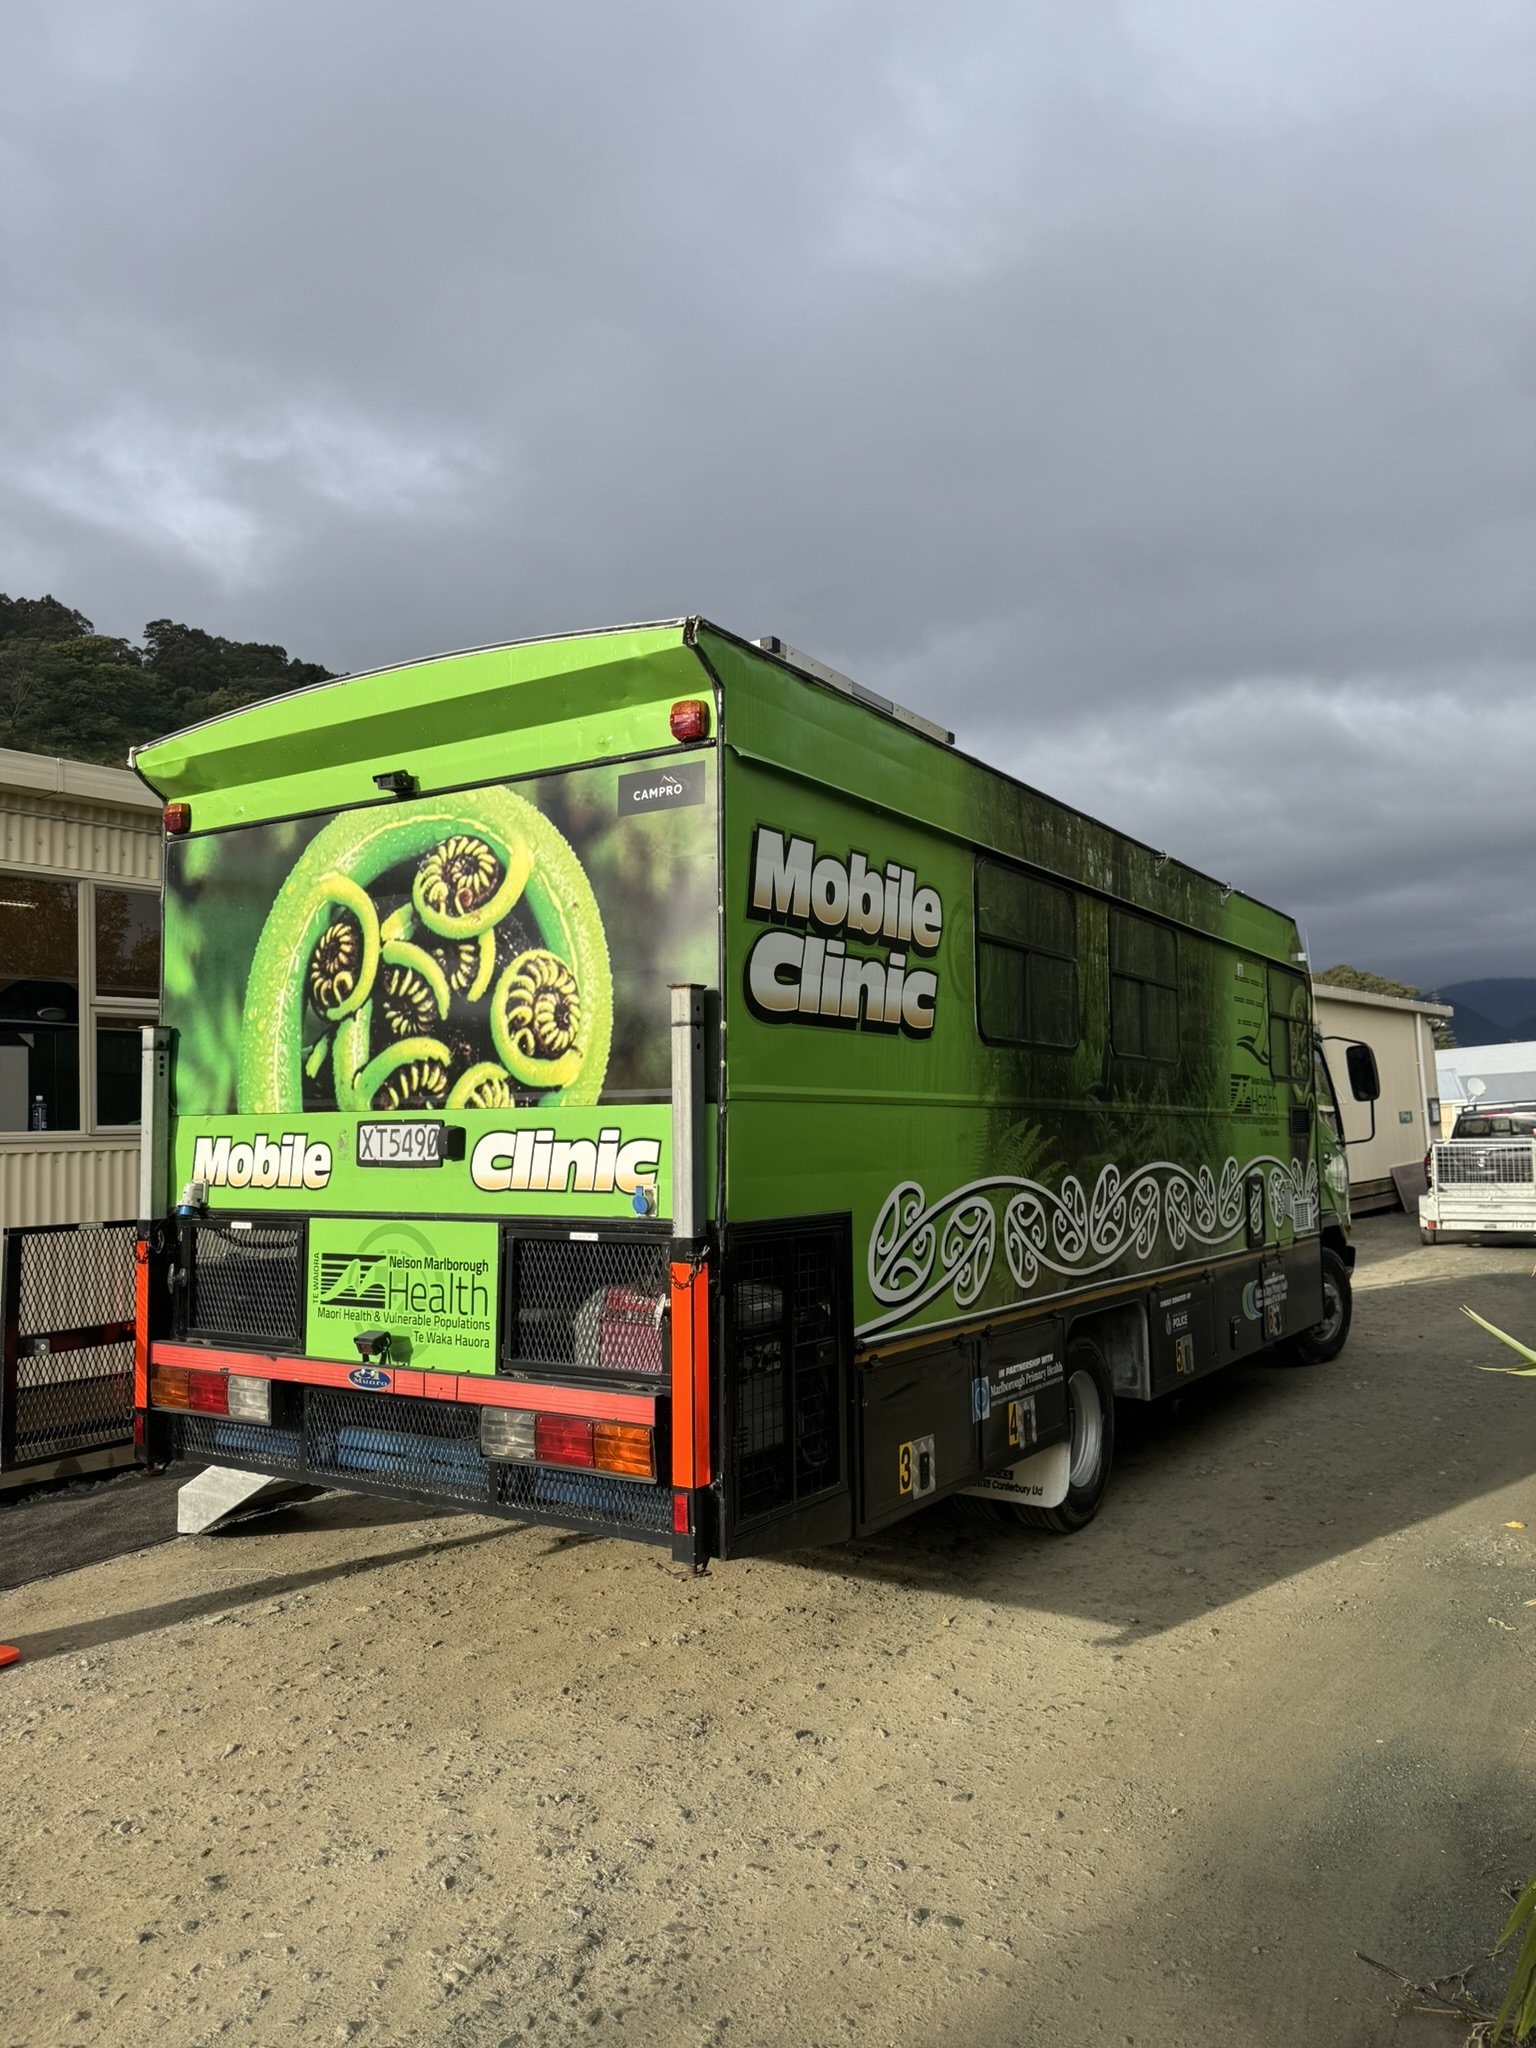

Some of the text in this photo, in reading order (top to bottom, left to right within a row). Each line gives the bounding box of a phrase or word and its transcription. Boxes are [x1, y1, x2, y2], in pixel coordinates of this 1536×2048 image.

[632, 783, 683, 801] CAMPRO
[748, 824, 943, 954] Mobile
[745, 929, 939, 1036] Clinic
[192, 1133, 333, 1190] Mobile
[361, 1127, 439, 1160] XT5490
[470, 1127, 662, 1195] Clinic
[312, 1252, 320, 1304] TE WAIORA
[389, 1255, 489, 1276] Nelson Marlborough
[388, 1271, 489, 1317] Health
[317, 1307, 491, 1331] Maori Health & Vulnerable Populations
[1172, 1314, 1188, 1329] POLICE
[414, 1330, 490, 1349] Te Waka Hauora
[353, 1377, 388, 1387] Munro
[1009, 1402, 1018, 1443] 4
[901, 1445, 911, 1490] 3
[991, 1480, 1031, 1497] Canterbury
[1031, 1485, 1044, 1496] Ltd
